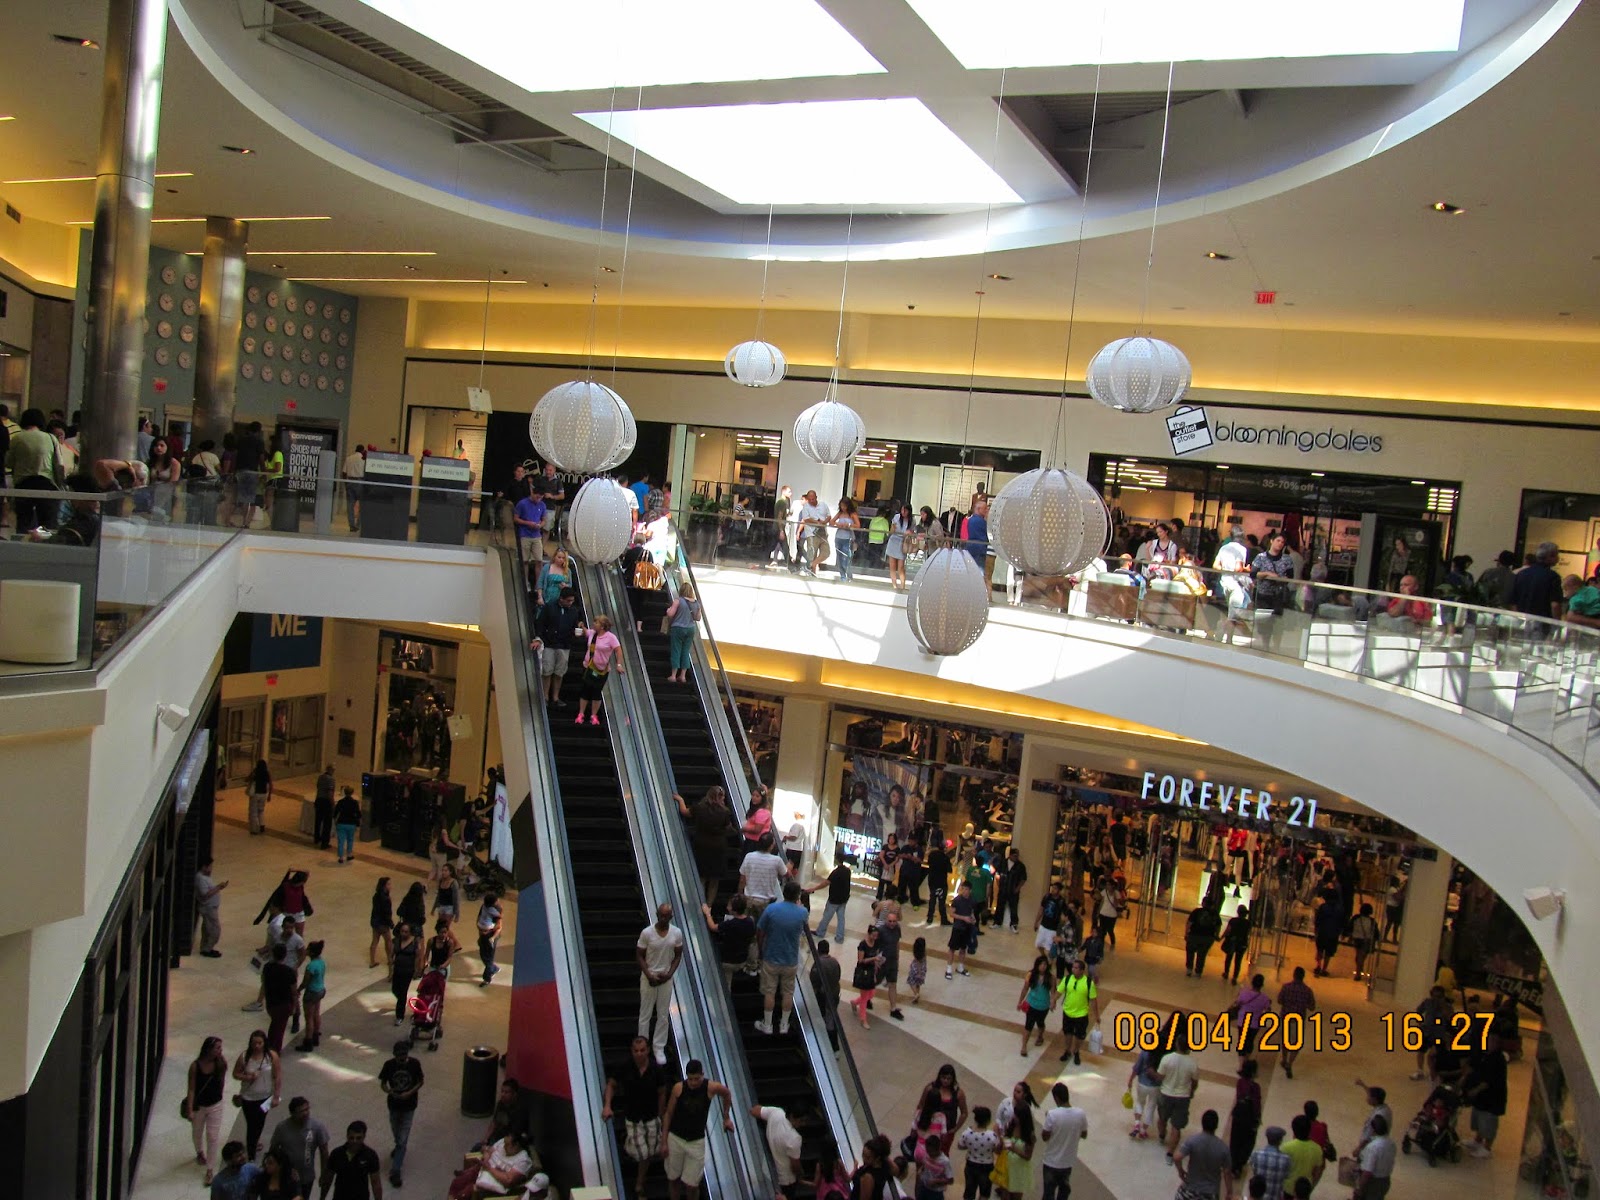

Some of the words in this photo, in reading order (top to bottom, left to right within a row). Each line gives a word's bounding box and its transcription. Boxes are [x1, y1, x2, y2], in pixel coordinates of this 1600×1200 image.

[1256, 291, 1276, 304] EXIT
[1172, 421, 1186, 429] the
[1174, 423, 1198, 436] outlet
[1176, 432, 1196, 443] store
[1214, 420, 1383, 453] bloomingdale's
[290, 444, 309, 454] SHOES
[289, 453, 319, 467] BORIN
[288, 480, 316, 490] SNEAKER
[1262, 478, 1300, 491] 35-70%
[1299, 482, 1315, 491] off
[1141, 771, 1272, 821] FOREVER
[1287, 796, 1318, 829] 21
